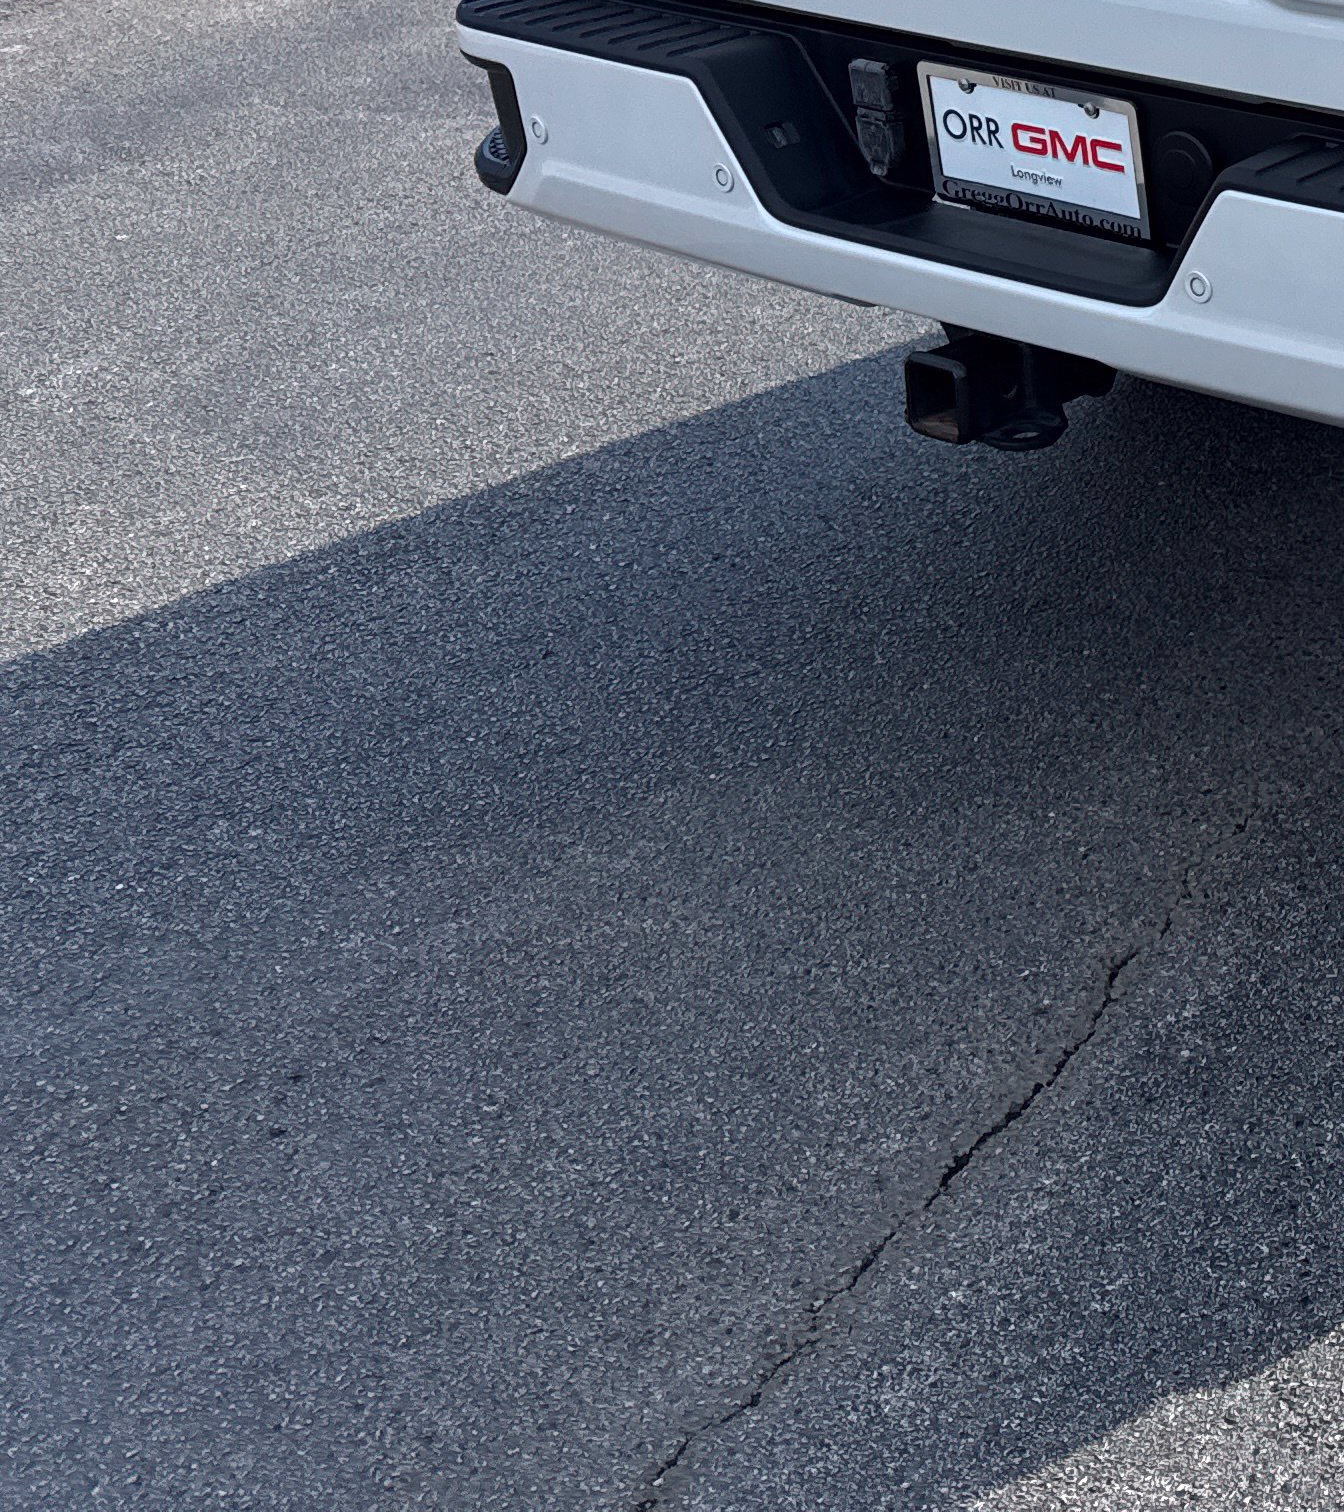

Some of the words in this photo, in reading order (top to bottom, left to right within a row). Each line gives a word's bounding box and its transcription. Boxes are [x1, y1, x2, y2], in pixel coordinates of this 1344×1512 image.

[992, 75, 1021, 92] VISIT
[1024, 82, 1040, 95] US
[1042, 87, 1057, 99] AT
[942, 108, 1004, 149] ORR
[1010, 122, 1125, 174] GMC
[1010, 165, 1063, 187] Longview
